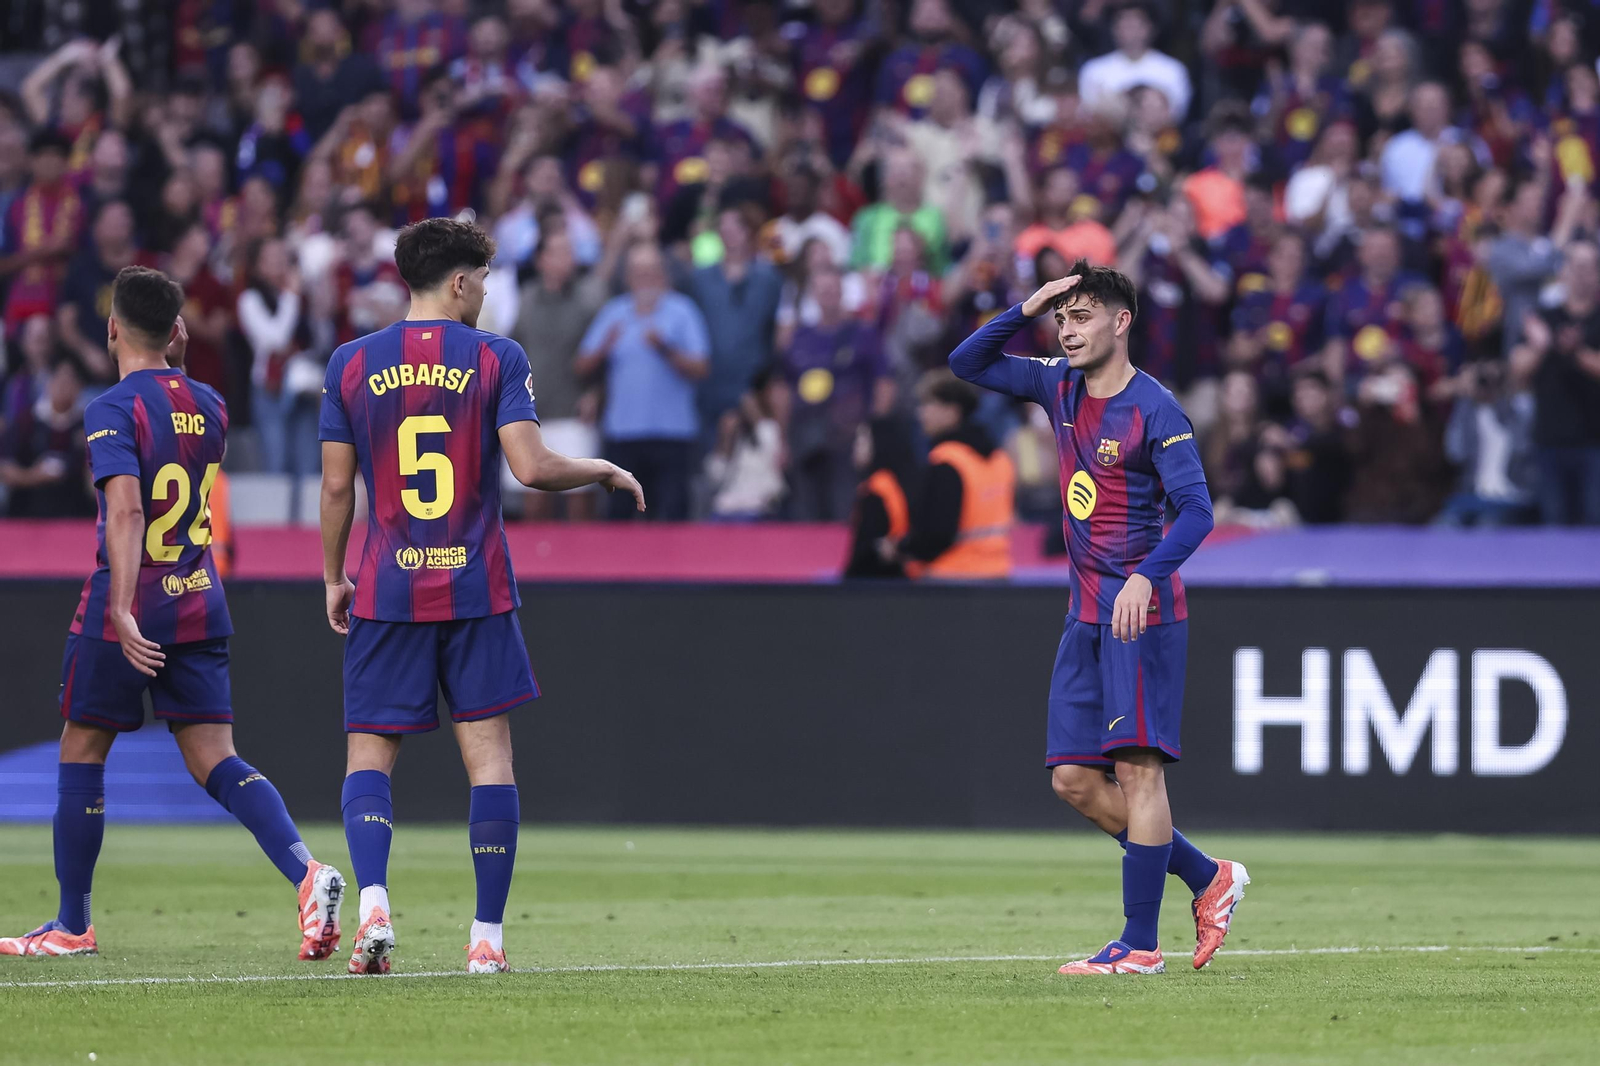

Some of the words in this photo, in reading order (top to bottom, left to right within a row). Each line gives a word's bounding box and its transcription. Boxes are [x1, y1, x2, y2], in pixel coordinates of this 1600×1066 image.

[368, 363, 475, 396] CUBARSÍ
[170, 412, 205, 436] ERIC
[397, 415, 455, 520] 5
[145, 462, 219, 562] 24
[425, 546, 467, 557] UNHCR
[425, 556, 467, 566] ACNUR
[1233, 647, 1569, 777] HMD
